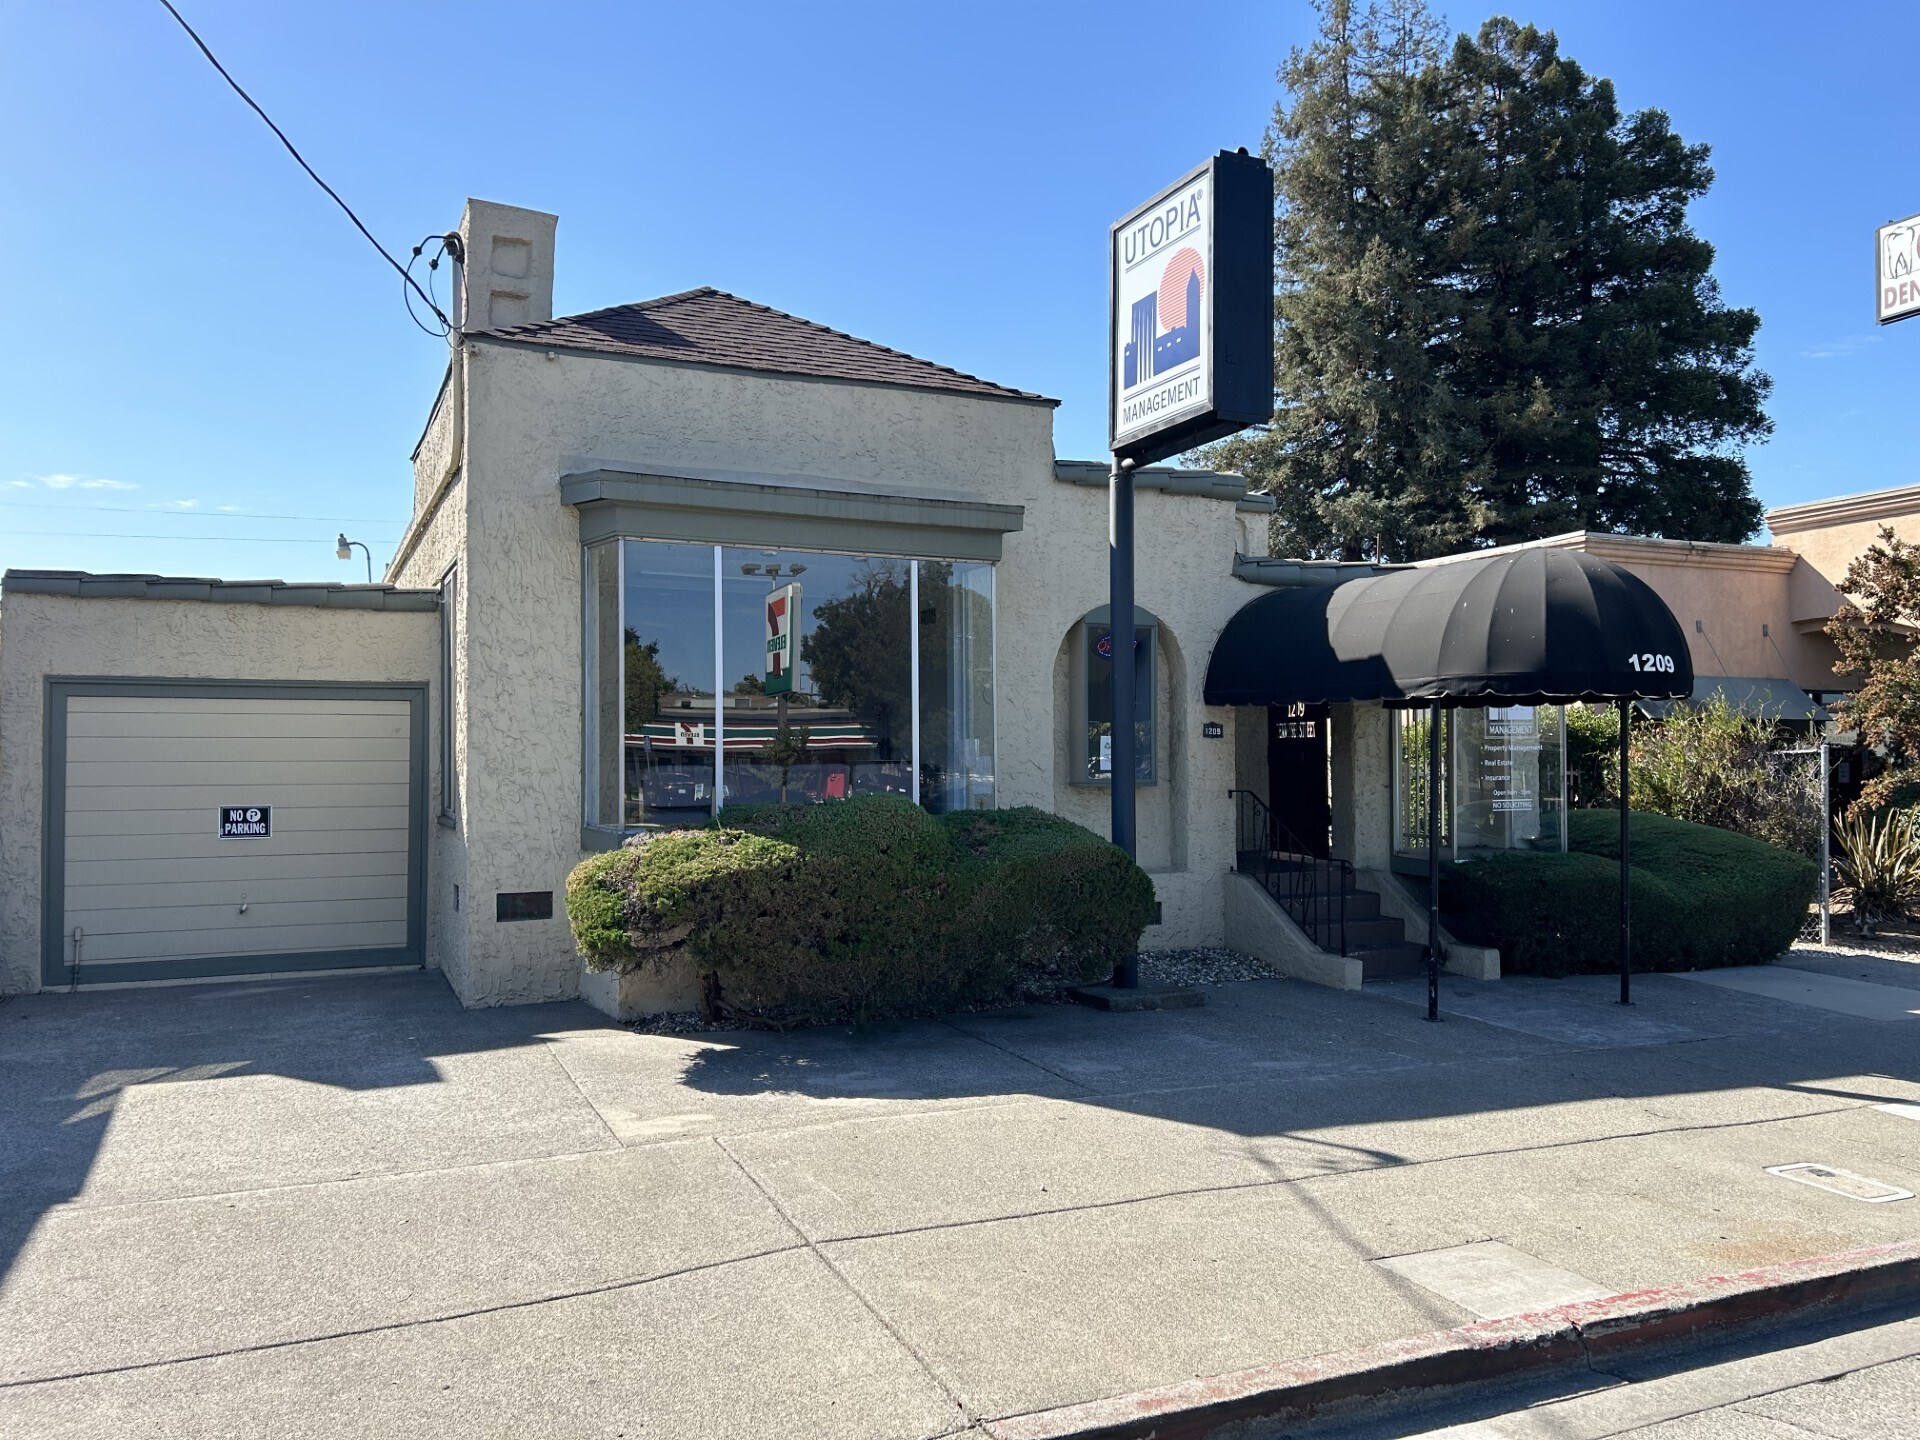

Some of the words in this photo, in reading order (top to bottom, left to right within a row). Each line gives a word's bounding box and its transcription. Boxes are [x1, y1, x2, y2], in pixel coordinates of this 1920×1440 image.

[1123, 376, 1201, 425] MANAGEMENT
[1628, 653, 1675, 673] 1209
[1205, 727, 1221, 735] 1209
[1490, 725, 1532, 734] MANAGEMENT
[1508, 745, 1543, 753] Management
[230, 809, 243, 821] NO
[225, 823, 266, 834] PARKING
